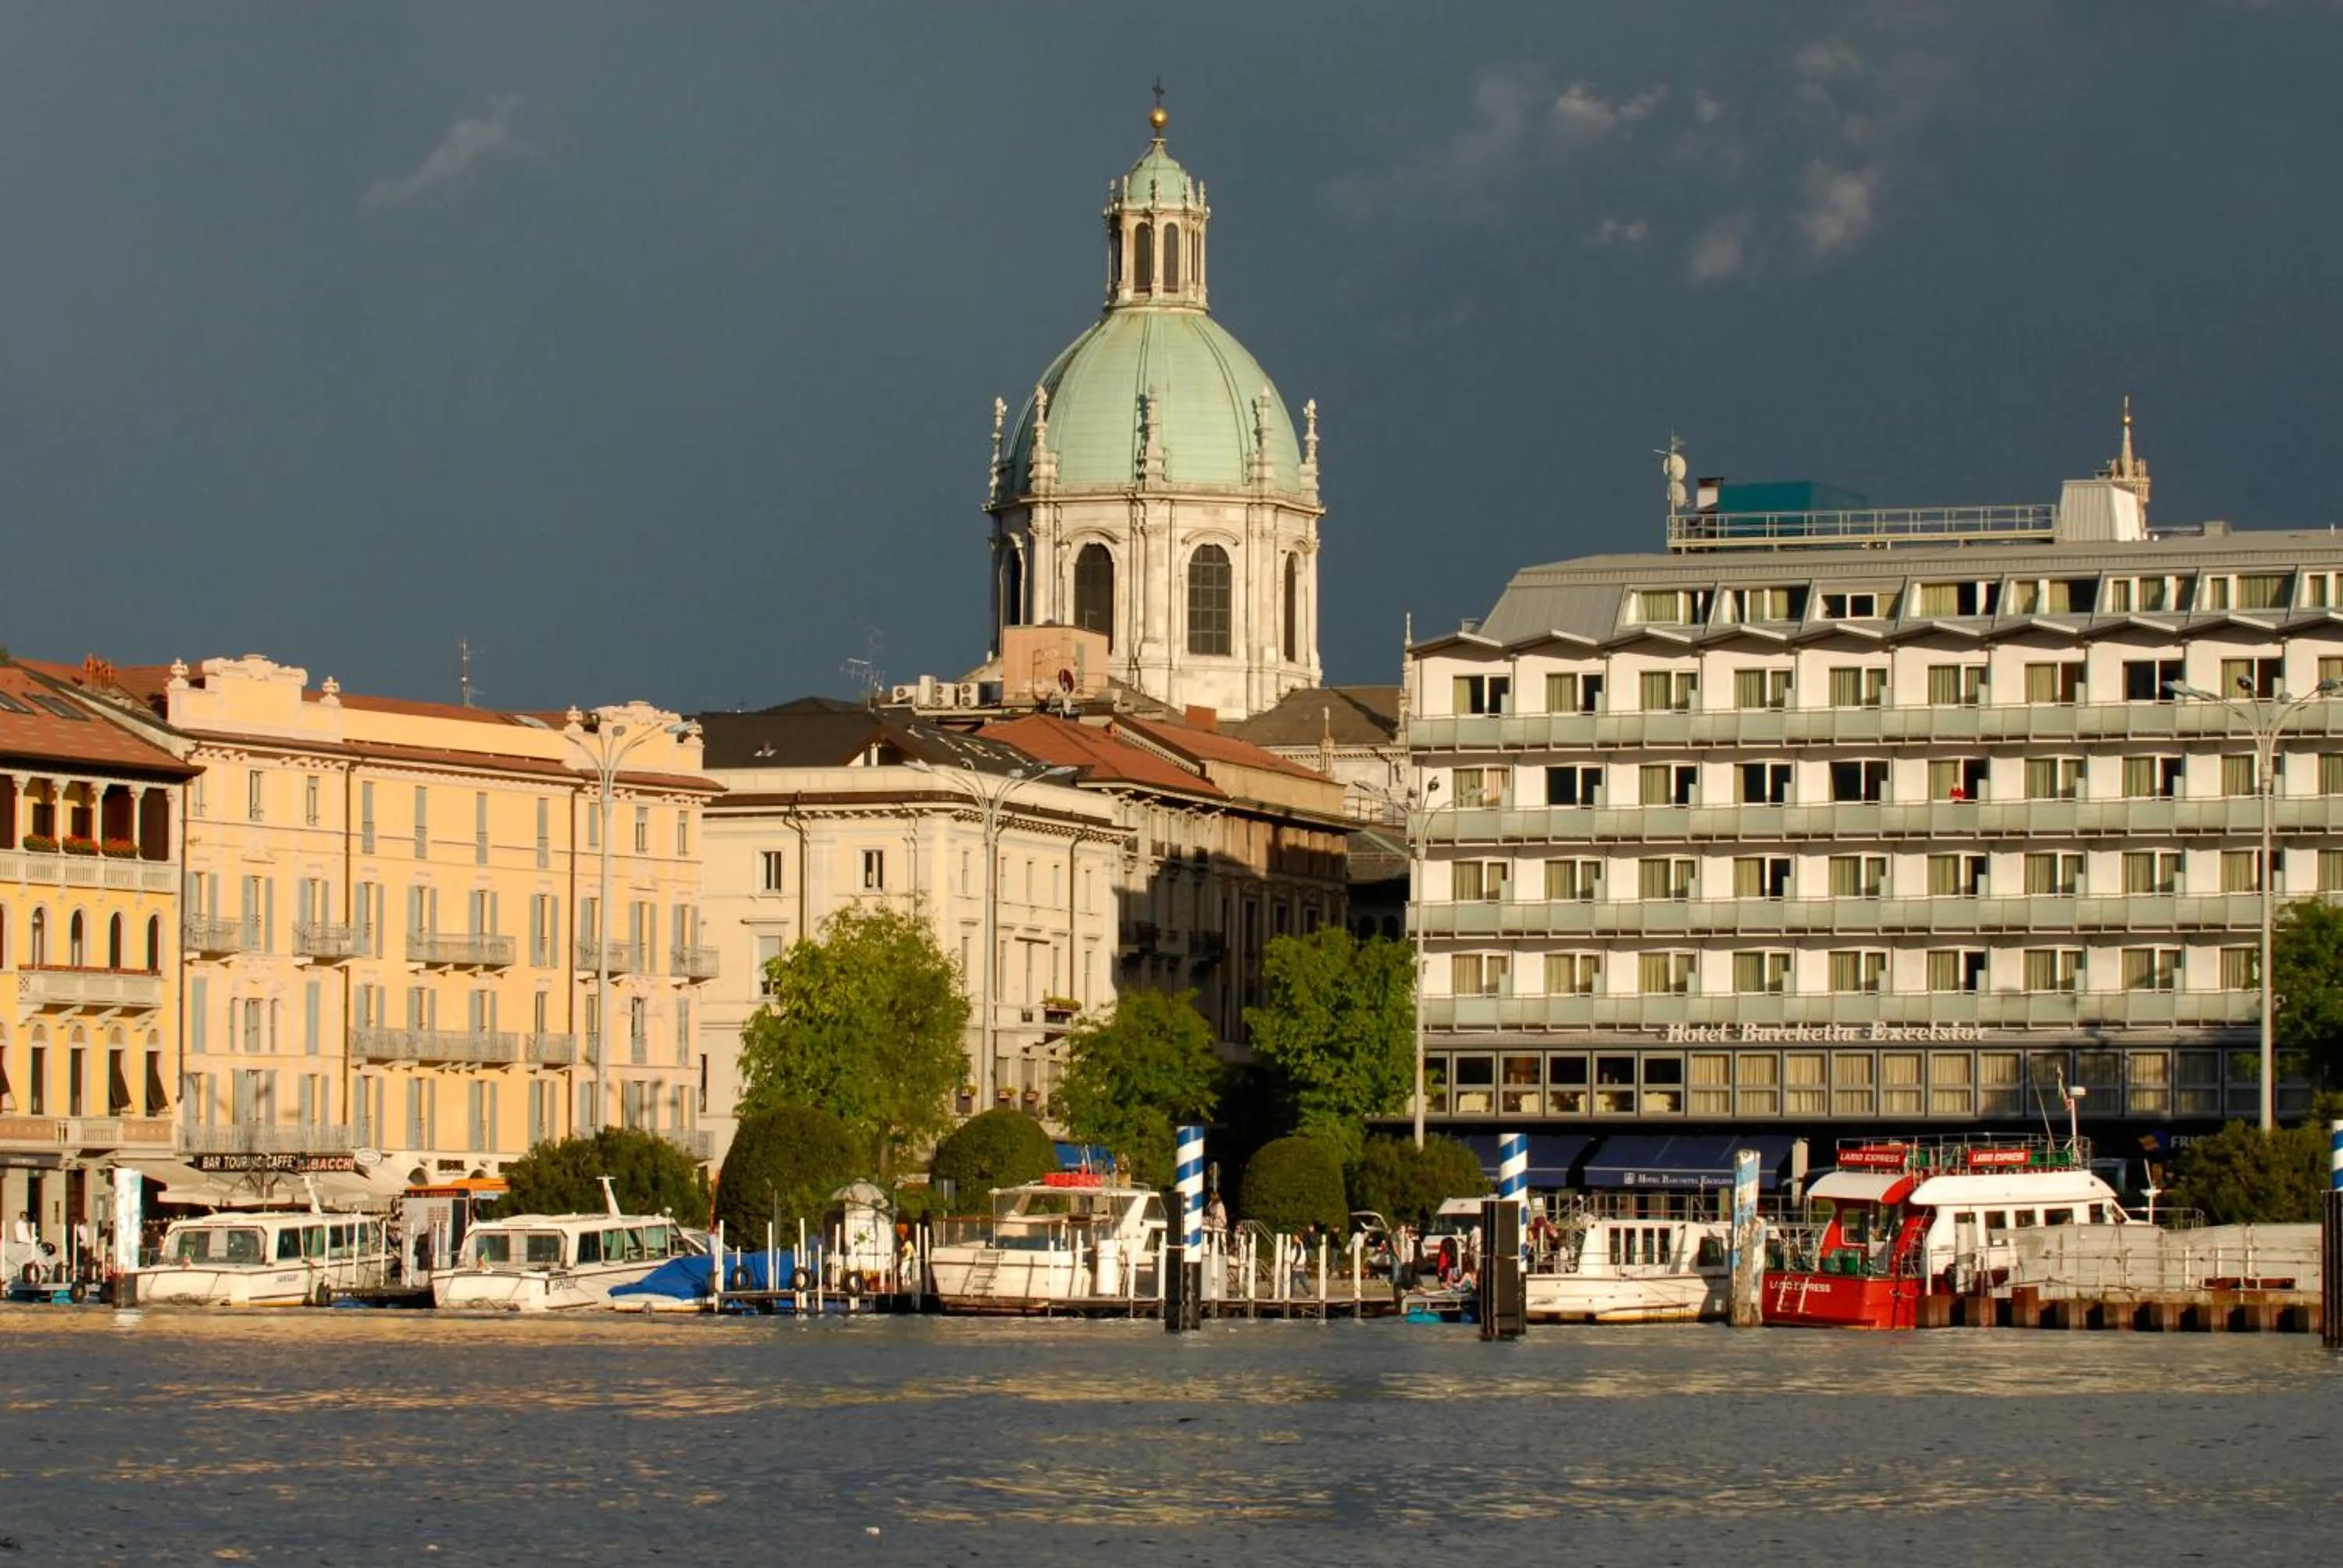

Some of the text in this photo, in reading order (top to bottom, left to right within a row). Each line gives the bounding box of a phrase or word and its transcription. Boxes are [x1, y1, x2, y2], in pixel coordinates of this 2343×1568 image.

[1667, 1022, 1728, 1042] Hotel
[1870, 1021, 1985, 1042] Excelsior
[201, 1156, 221, 1169] BAR
[298, 1157, 355, 1171] BACCHI
